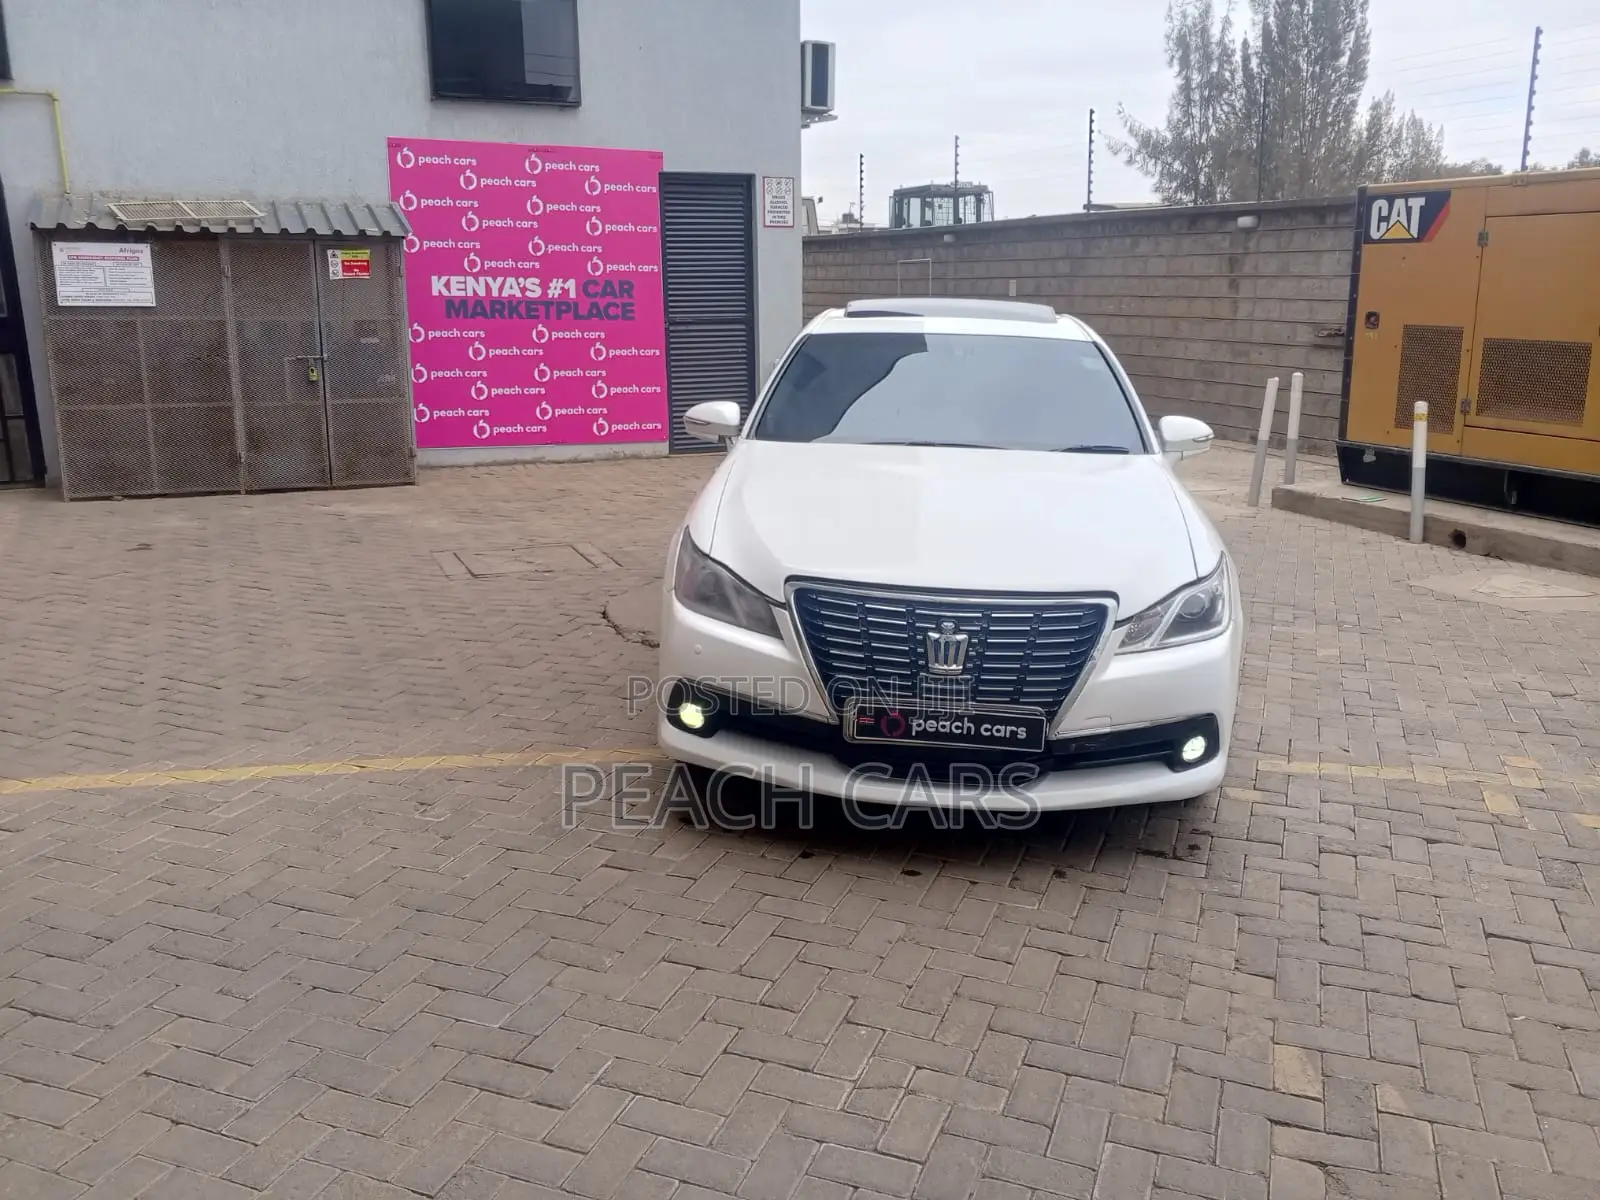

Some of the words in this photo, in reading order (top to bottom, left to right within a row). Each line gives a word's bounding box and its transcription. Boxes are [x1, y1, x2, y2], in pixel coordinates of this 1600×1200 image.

[418, 155, 452, 167] peach
[452, 157, 477, 166] cars
[544, 161, 577, 173] peach
[577, 163, 601, 173] cars
[479, 176, 513, 188] peach
[513, 179, 537, 188] cars
[603, 183, 635, 194] peach
[634, 185, 657, 193] cars
[420, 197, 454, 209] peach
[455, 199, 479, 208] cars
[546, 202, 578, 214] peach
[578, 204, 602, 213] cars
[482, 218, 514, 230] peach
[515, 220, 539, 229] cars
[1370, 196, 1426, 240] CAT
[604, 223, 636, 234] peach
[636, 224, 658, 233] cars
[422, 239, 456, 251] peach
[457, 241, 481, 250] cars
[547, 243, 579, 254] peach
[580, 245, 603, 253] cars
[483, 259, 516, 271] peach
[516, 261, 540, 269] cars
[606, 263, 637, 274] peach
[637, 264, 659, 273] cars
[431, 275, 542, 298] KENYA'S
[547, 278, 576, 299] #1
[582, 279, 635, 299] CAR
[445, 299, 635, 321] MARKETPLACE
[428, 328, 461, 340] peach
[462, 330, 486, 339] cars
[551, 330, 582, 341] peach
[583, 332, 606, 340] cars
[488, 347, 521, 358] peach
[521, 348, 544, 356] cars
[608, 347, 639, 359] peach
[430, 369, 463, 381] peach
[464, 370, 488, 379] cars
[553, 368, 584, 380] peach
[584, 370, 607, 378] cars
[491, 386, 522, 398] peach
[523, 387, 546, 395] cars
[610, 385, 640, 396] peach
[640, 386, 661, 394] cars
[433, 408, 466, 420] peach
[466, 409, 490, 418] cars
[554, 406, 585, 418] peach
[586, 407, 608, 415] cars
[493, 424, 524, 436] peach
[525, 425, 547, 433] cars
[611, 422, 640, 433] peach
[911, 716, 975, 736] peach
[980, 723, 1028, 739] cars
